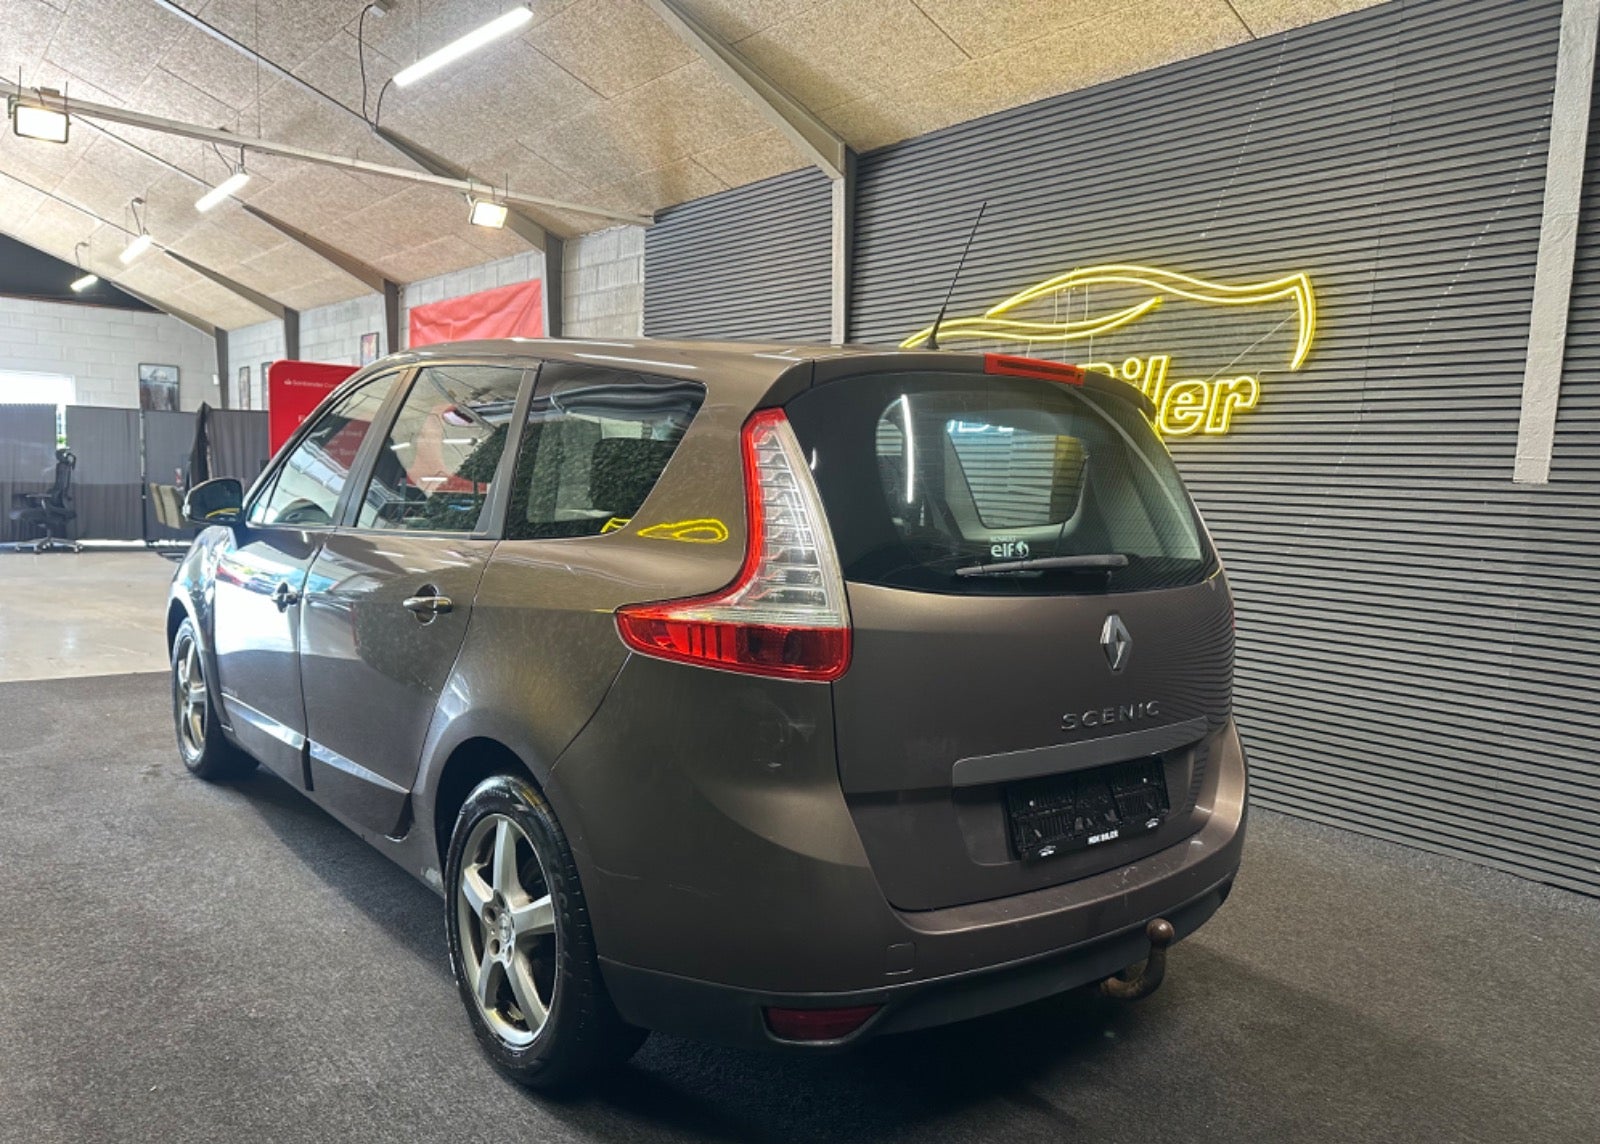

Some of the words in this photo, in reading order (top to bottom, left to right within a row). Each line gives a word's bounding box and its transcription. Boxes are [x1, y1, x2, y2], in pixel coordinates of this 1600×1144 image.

[1080, 355, 1261, 435] ler
[991, 543, 1015, 557] elf
[1061, 700, 1160, 730] SCENIC
